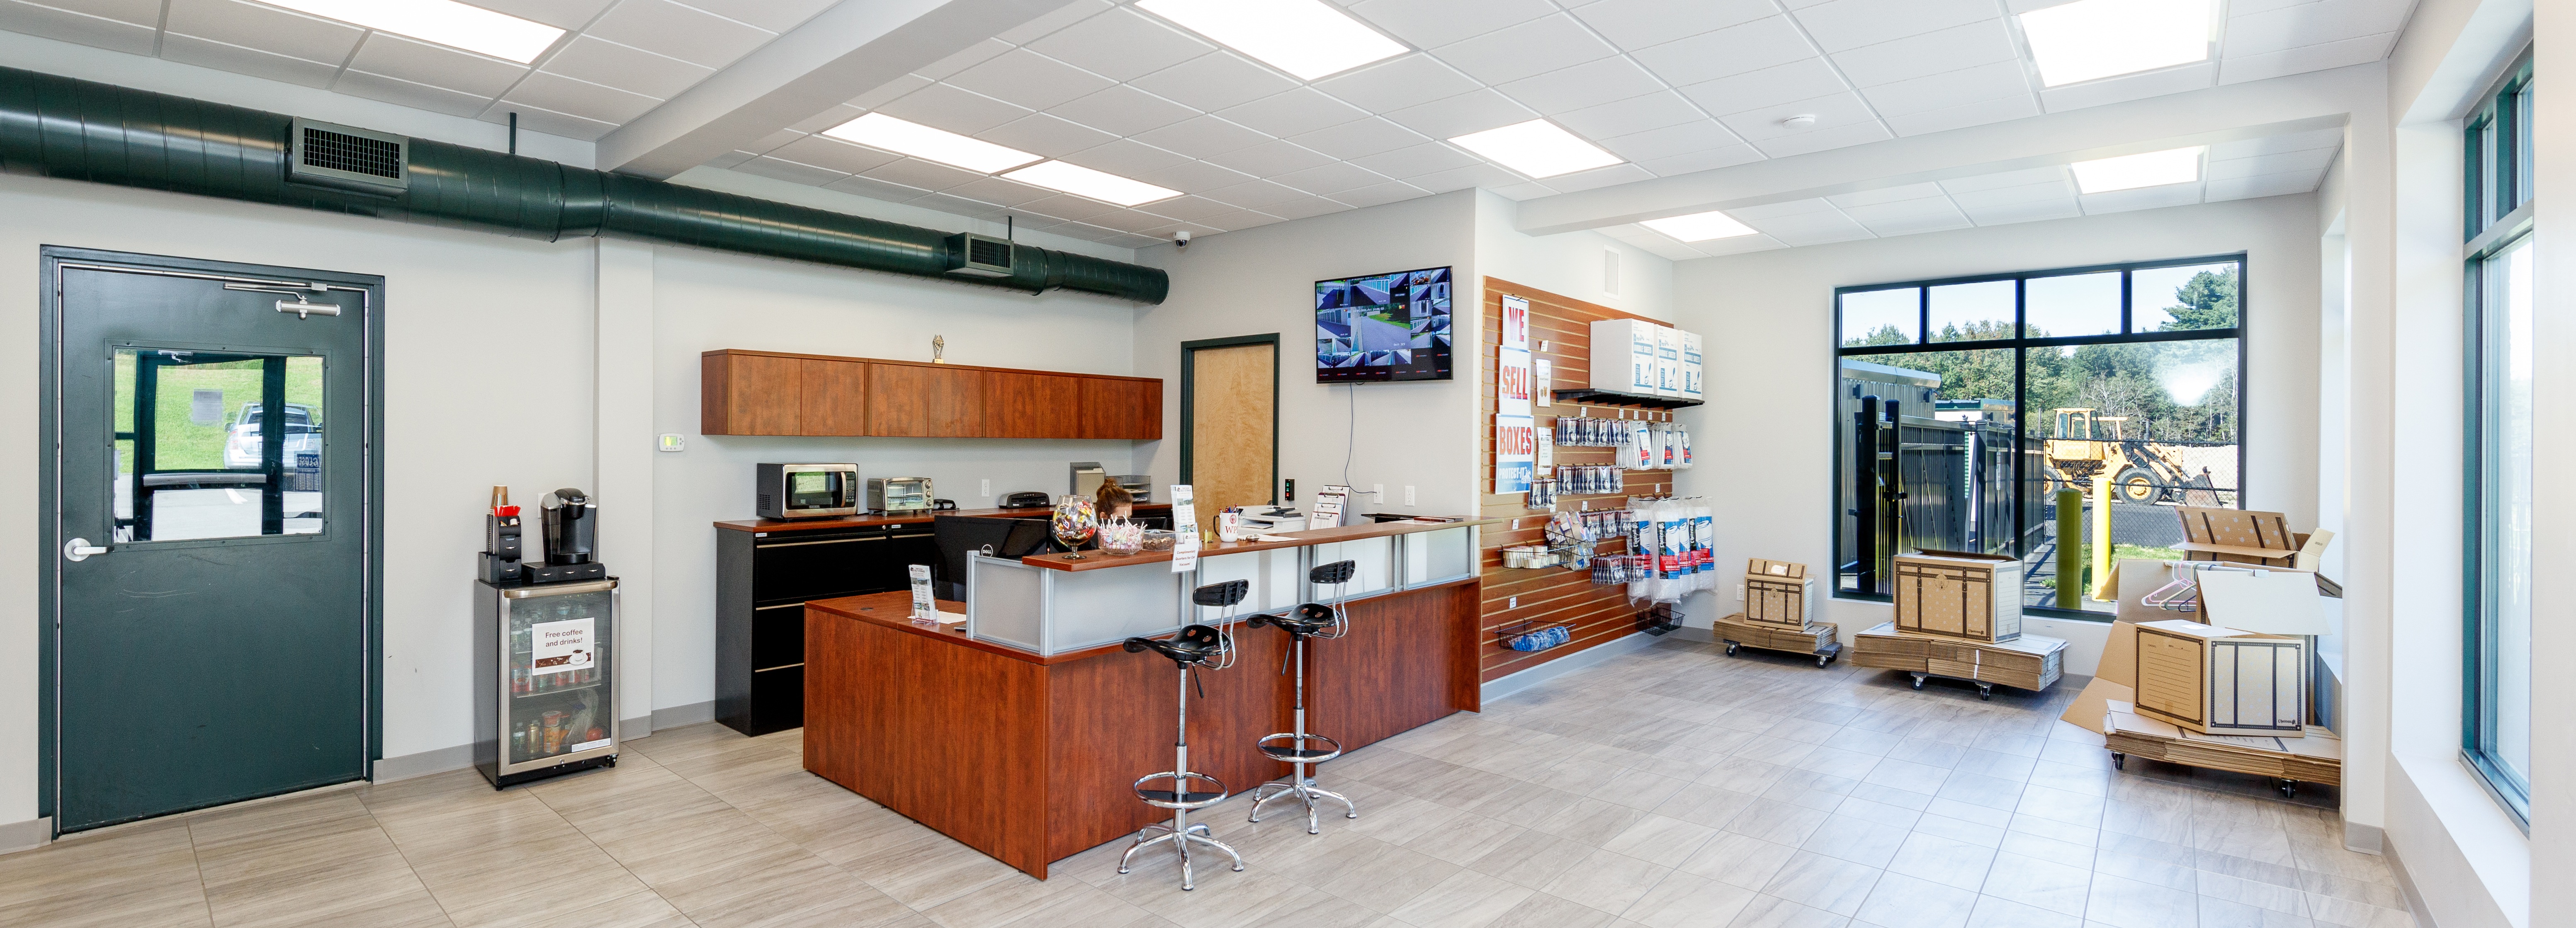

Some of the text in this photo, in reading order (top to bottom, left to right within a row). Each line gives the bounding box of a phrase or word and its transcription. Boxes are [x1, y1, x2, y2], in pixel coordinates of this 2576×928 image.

[1509, 306, 1524, 342] WE
[1502, 366, 1528, 400] SELL
[1499, 426, 1531, 455] BOXES
[1499, 467, 1525, 479] PROTECT-IT
